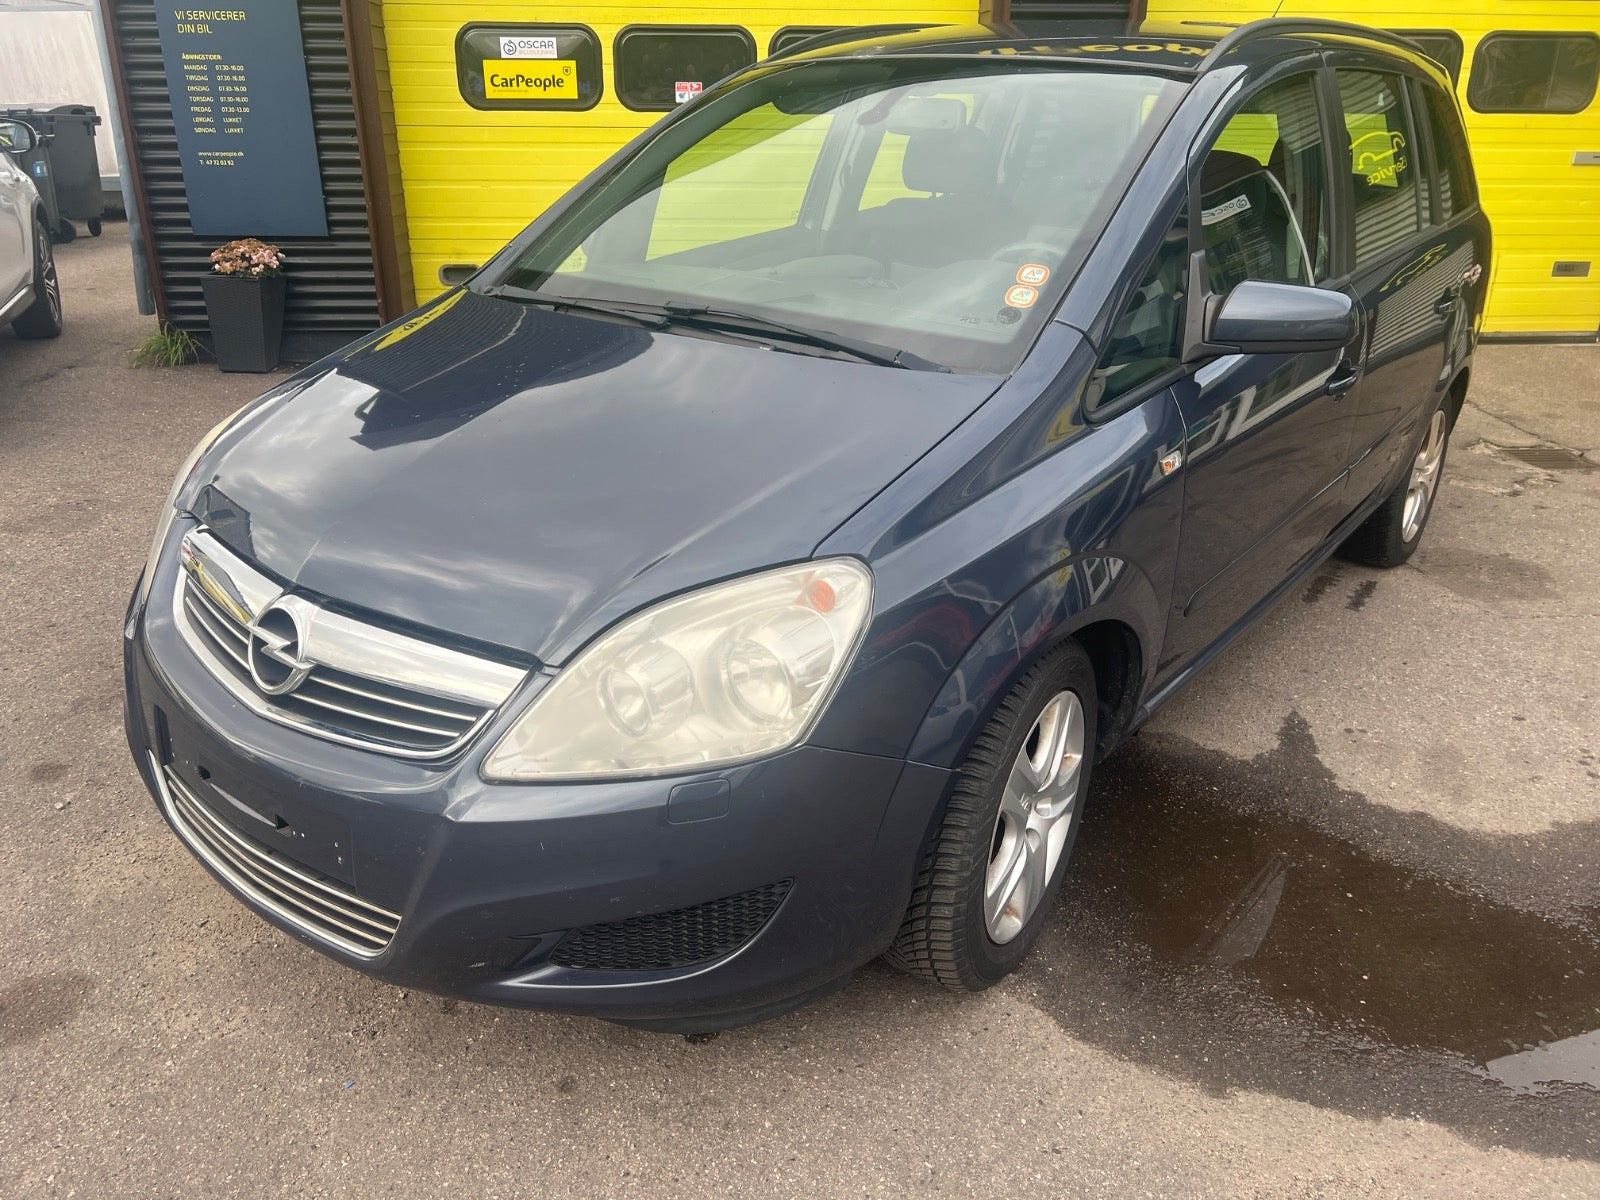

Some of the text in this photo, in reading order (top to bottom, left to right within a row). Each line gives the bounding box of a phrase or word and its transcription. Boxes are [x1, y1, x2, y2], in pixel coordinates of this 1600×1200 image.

[174, 10, 246, 21] VI SERVICERER
[177, 23, 213, 34] DIN BIL
[518, 40, 554, 49] OSCAR
[489, 74, 564, 92] CarPeople
